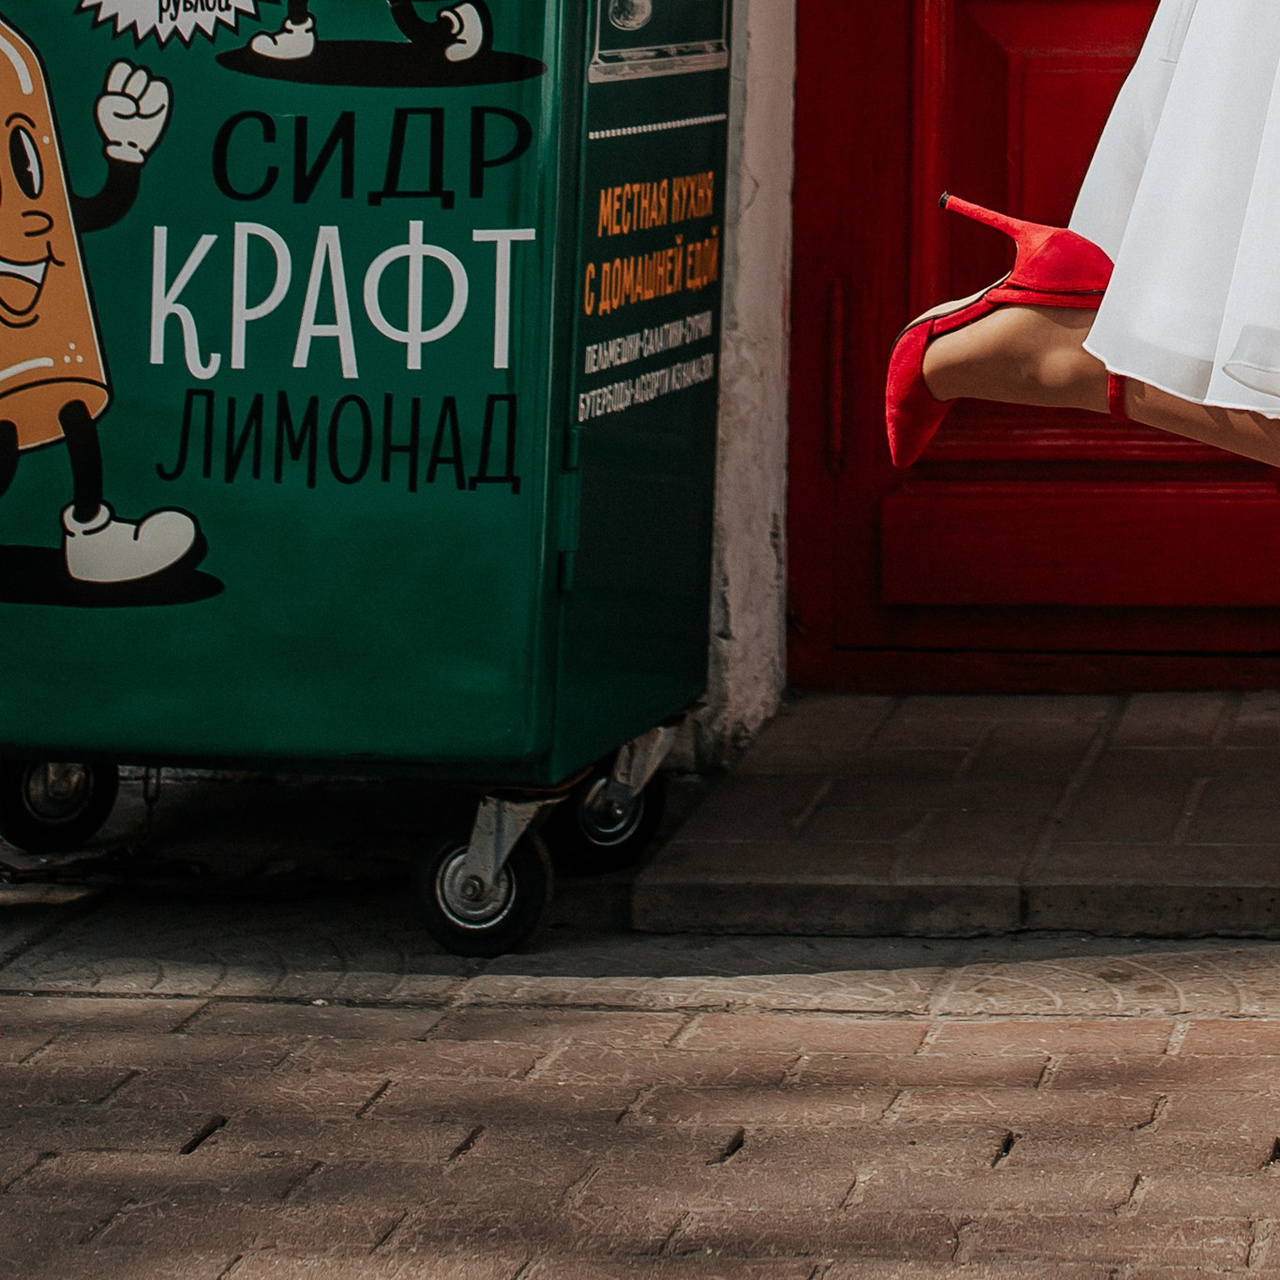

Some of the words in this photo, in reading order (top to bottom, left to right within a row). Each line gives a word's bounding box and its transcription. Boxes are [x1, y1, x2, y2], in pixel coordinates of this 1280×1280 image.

[211, 104, 533, 210] СИДР
[597, 178, 667, 238] МЕСТНАЯ
[150, 220, 536, 380] КРАФТ
[584, 262, 596, 317] С
[598, 234, 683, 317] ДОМАШНЕЙ
[156, 389, 521, 495] ЛИМОНАД
